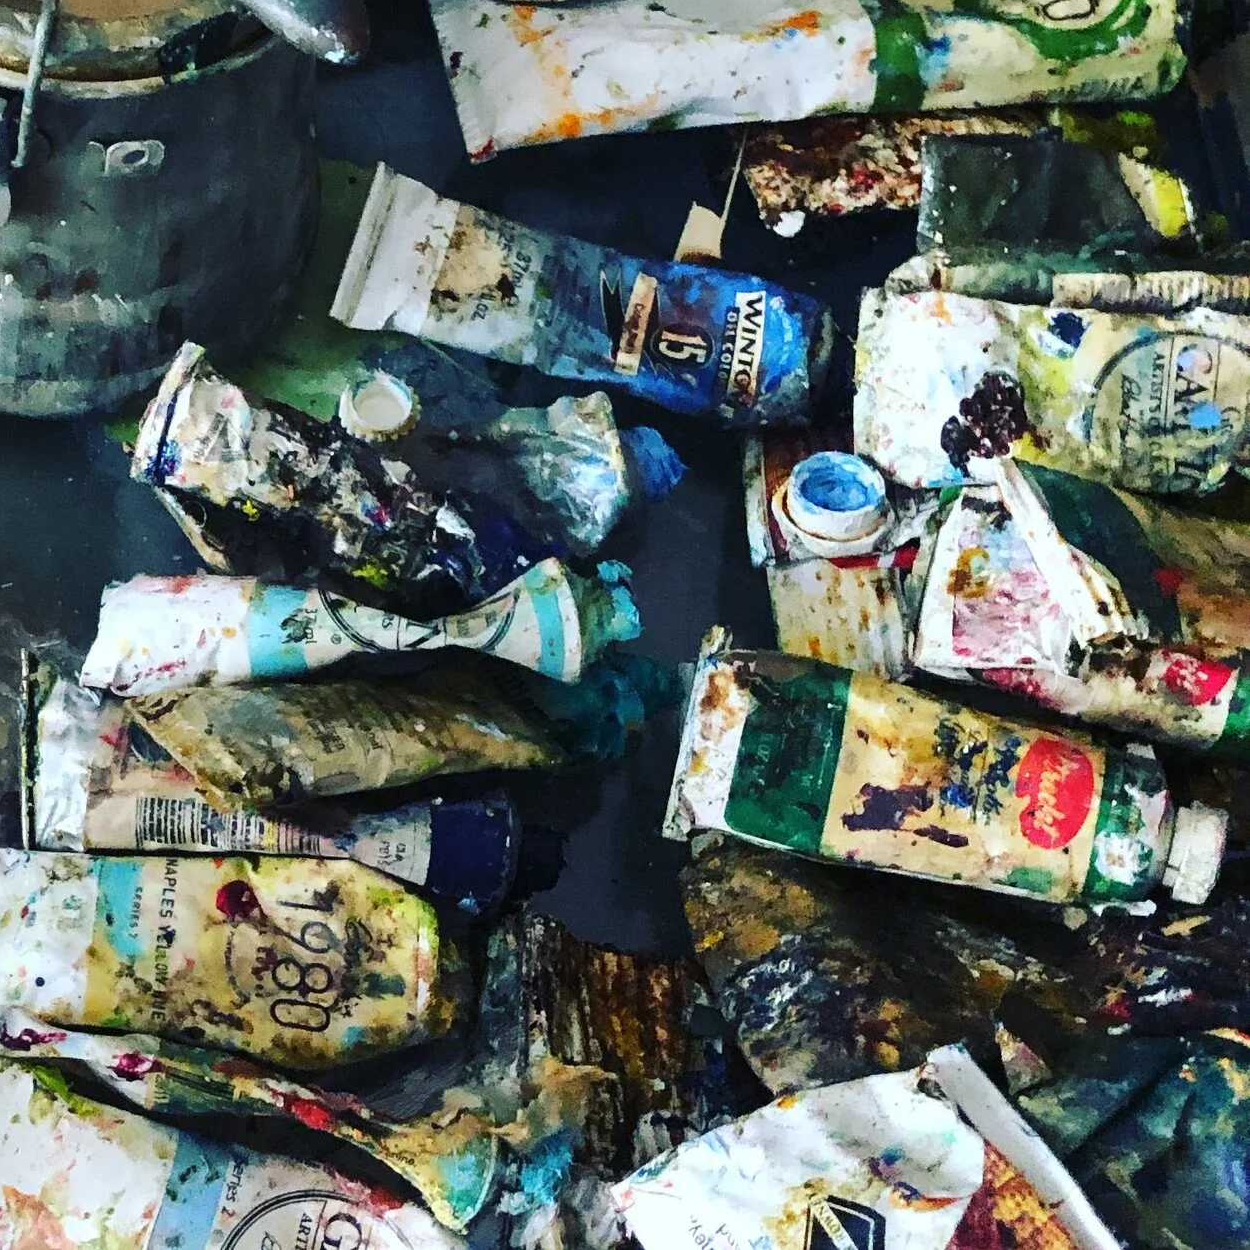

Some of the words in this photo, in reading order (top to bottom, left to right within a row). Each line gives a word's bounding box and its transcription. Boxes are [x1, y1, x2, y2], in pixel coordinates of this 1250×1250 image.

[657, 329, 709, 365] 15
[732, 294, 764, 407] WINTO
[128, 886, 144, 929] SERIES
[160, 856, 179, 919] NAPLES
[269, 883, 340, 1033] 1980
